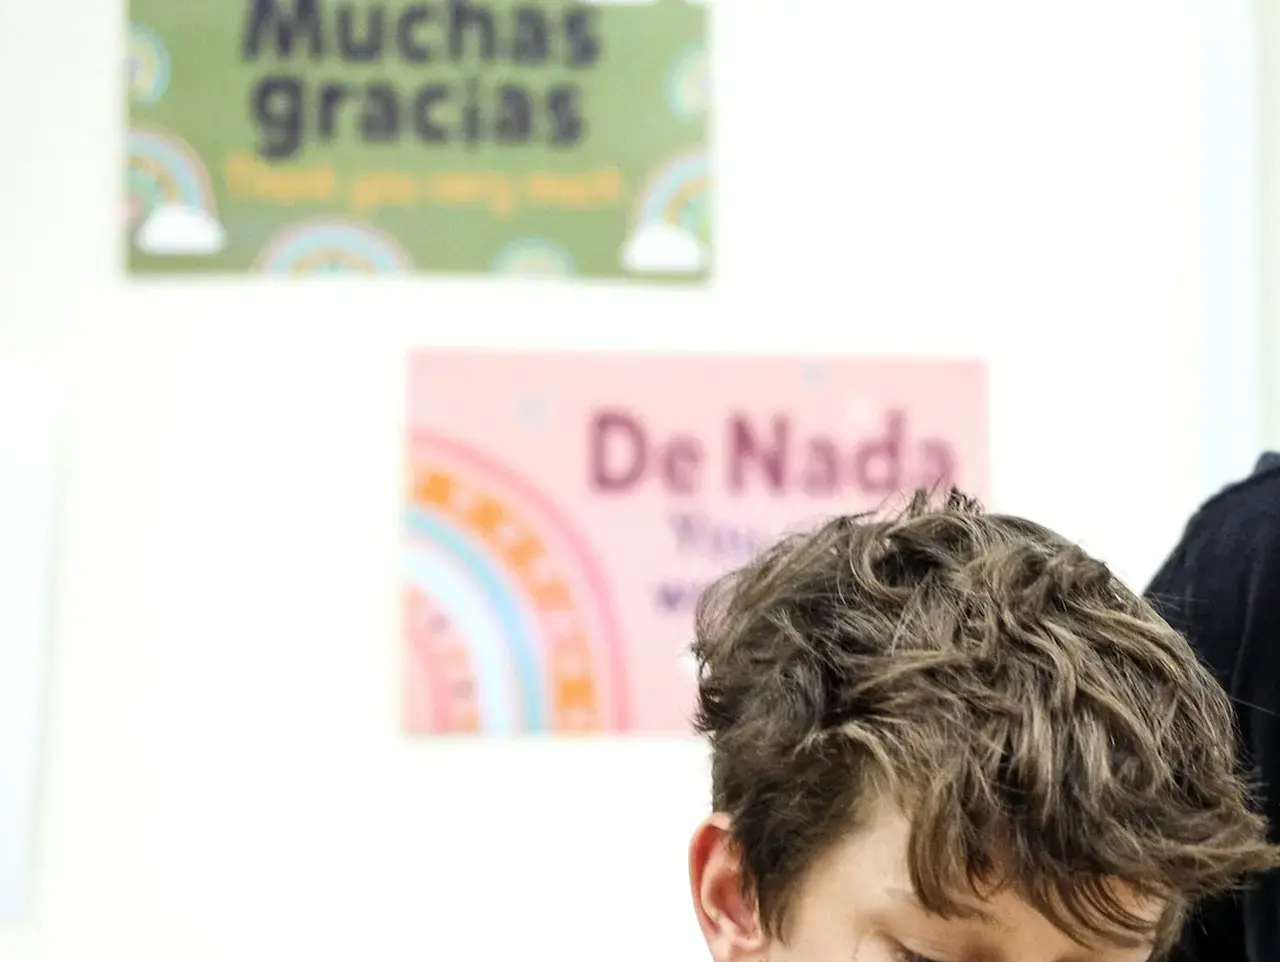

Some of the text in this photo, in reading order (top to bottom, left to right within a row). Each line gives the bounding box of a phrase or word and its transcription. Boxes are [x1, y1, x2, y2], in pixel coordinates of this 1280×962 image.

[241, 0, 602, 66] Muchas
[249, 74, 587, 161] gracias
[588, 407, 957, 497] De Nada
